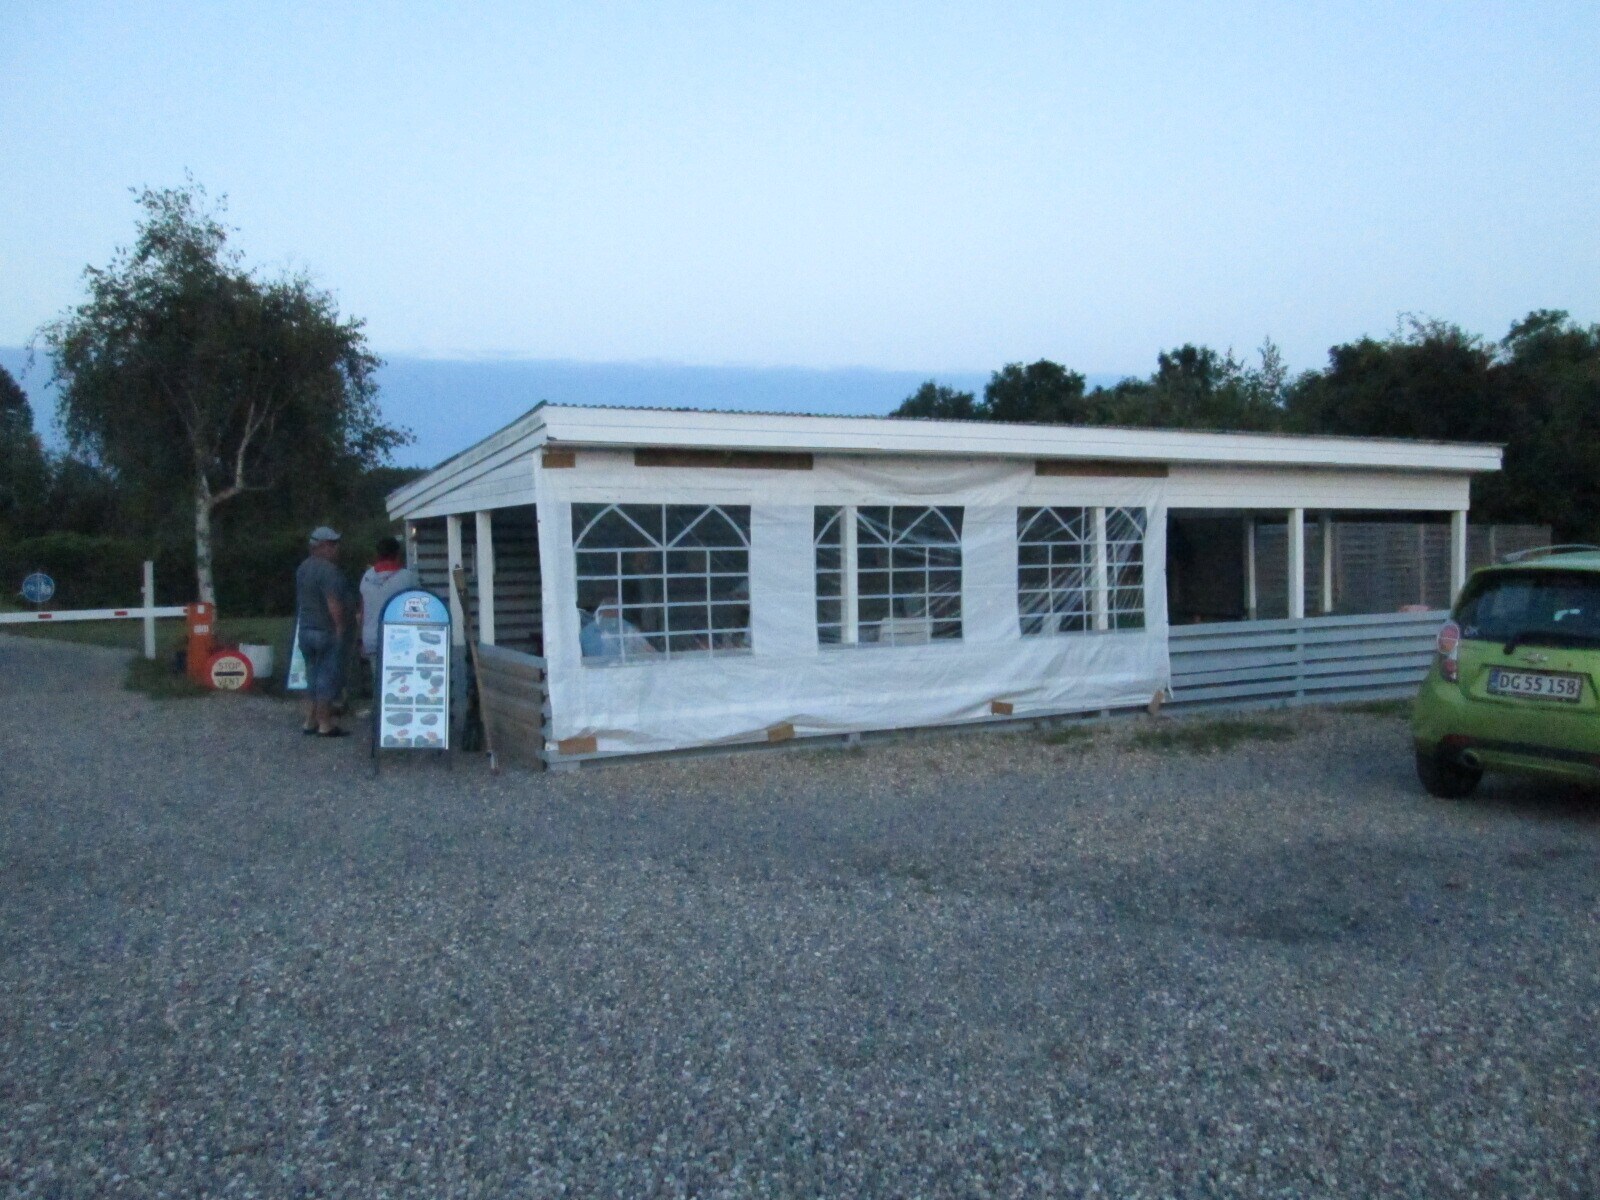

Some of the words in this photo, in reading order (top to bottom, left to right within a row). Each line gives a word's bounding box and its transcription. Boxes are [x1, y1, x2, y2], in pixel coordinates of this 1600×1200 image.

[219, 662, 241, 671] STOP
[1500, 674, 1521, 690] DG
[1524, 676, 1543, 692] 55
[1547, 679, 1576, 695] 158
